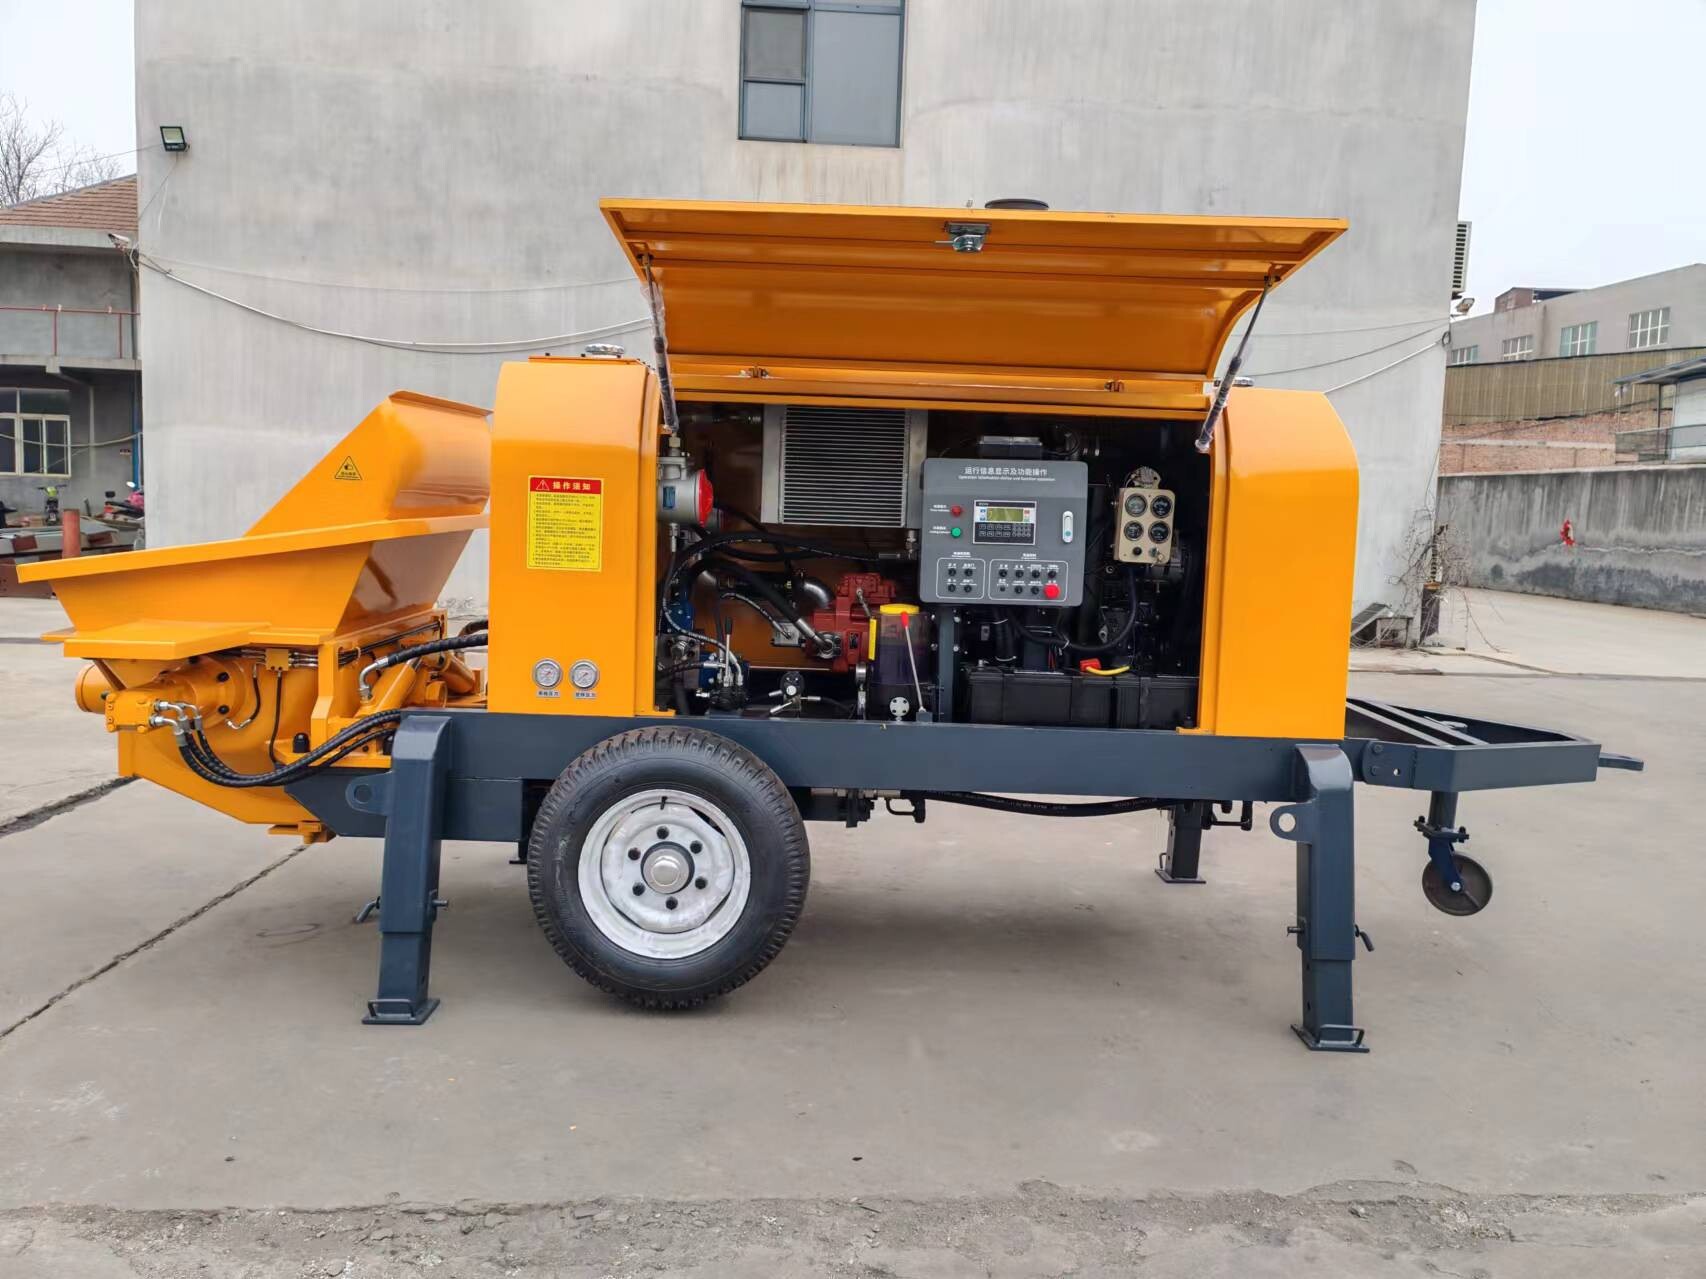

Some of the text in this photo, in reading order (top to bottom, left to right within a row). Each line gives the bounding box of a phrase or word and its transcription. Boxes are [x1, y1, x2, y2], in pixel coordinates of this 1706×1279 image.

[964, 466, 1048, 476] 运行信息显示及功能操作
